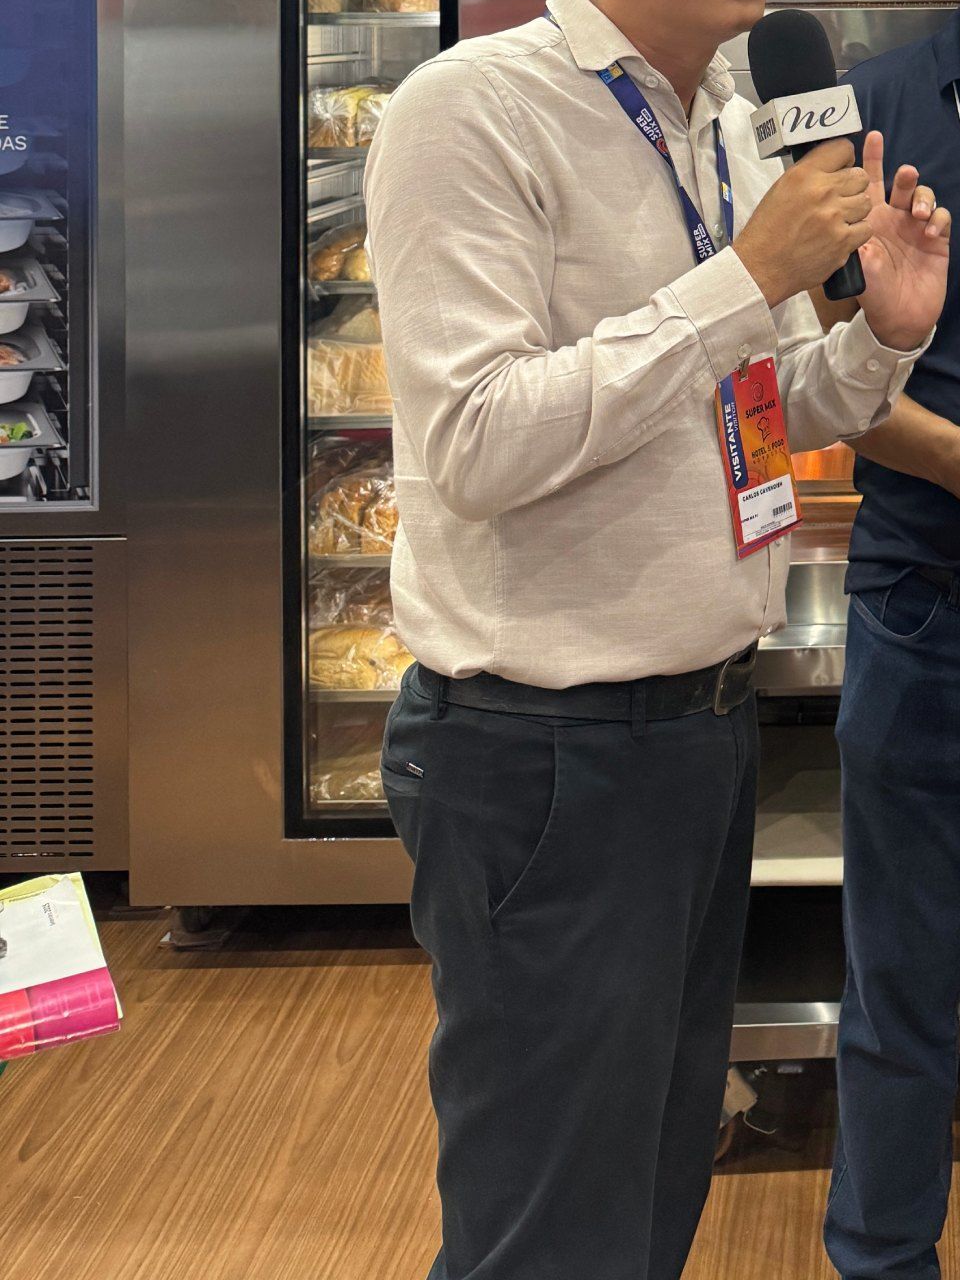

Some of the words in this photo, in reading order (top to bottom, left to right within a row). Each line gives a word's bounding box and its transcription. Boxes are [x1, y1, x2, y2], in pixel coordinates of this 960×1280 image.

[636, 115, 659, 141] SUPER
[756, 117, 777, 142] REVISTA
[782, 94, 850, 133] ne
[0, 136, 27, 150] AS
[693, 228, 708, 258] SUPER
[745, 405, 764, 419] SUPER
[724, 403, 742, 481] VISITANTE
[751, 446, 767, 459] HOTEL
[742, 491, 760, 502] CARLOS
